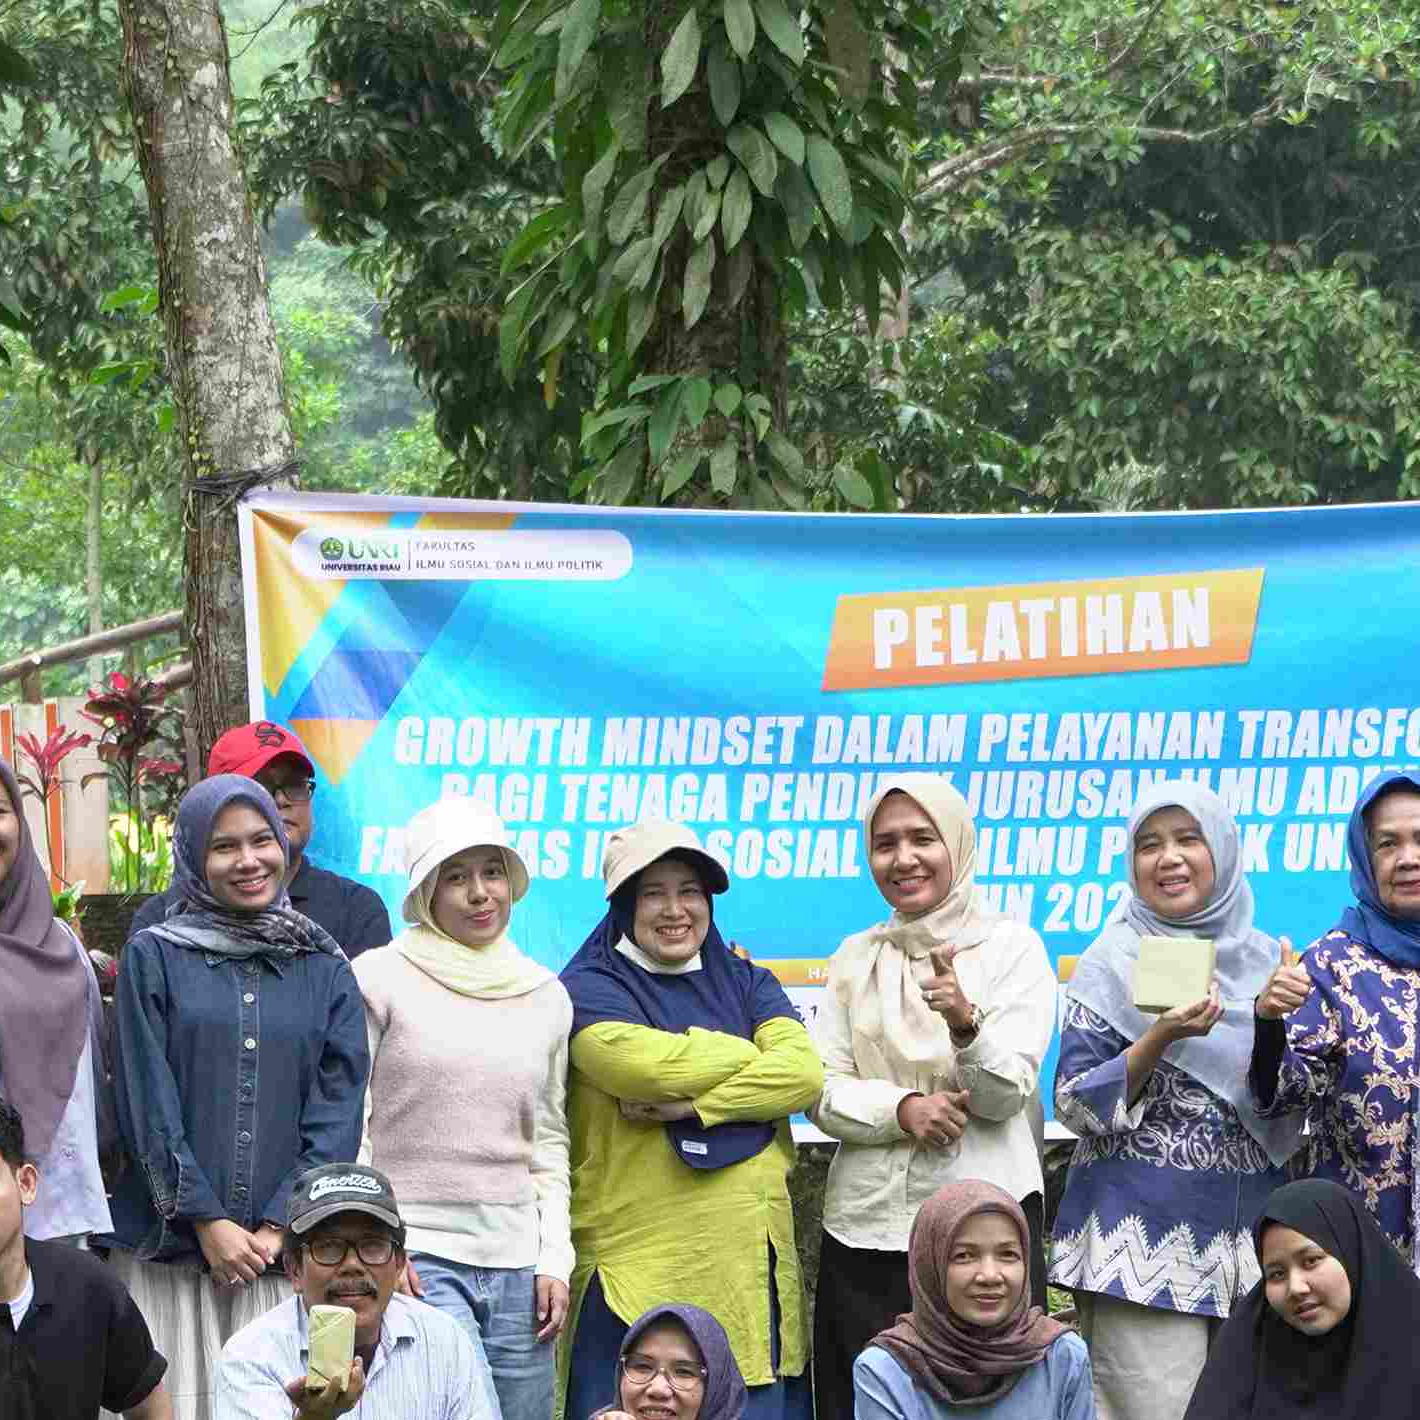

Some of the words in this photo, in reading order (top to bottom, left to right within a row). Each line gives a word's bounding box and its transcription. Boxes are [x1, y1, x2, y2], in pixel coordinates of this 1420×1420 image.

[320, 562, 379, 573] UNIVERSITAS
[379, 562, 402, 573] RIAU
[415, 540, 476, 552] FAKULTAS
[415, 558, 446, 570] ILMU
[448, 558, 492, 570] SOSIAL
[495, 559, 521, 570] DAN
[524, 559, 554, 570] ILMU
[557, 559, 604, 571] POLITIK
[872, 587, 1212, 670] PELATIHAN
[393, 717, 588, 768] GROWTH
[602, 715, 802, 766] MINDSET
[811, 713, 968, 763] DALAM
[978, 709, 1226, 764] PELAYANAN
[560, 772, 729, 822] TENAGA
[740, 771, 956, 822] PENDI
[1181, 766, 1286, 816] MU
[359, 827, 572, 880] FAAS
[704, 829, 862, 878] SOSIAL
[977, 826, 1088, 876] ILMU
[1043, 881, 1134, 933] 202
